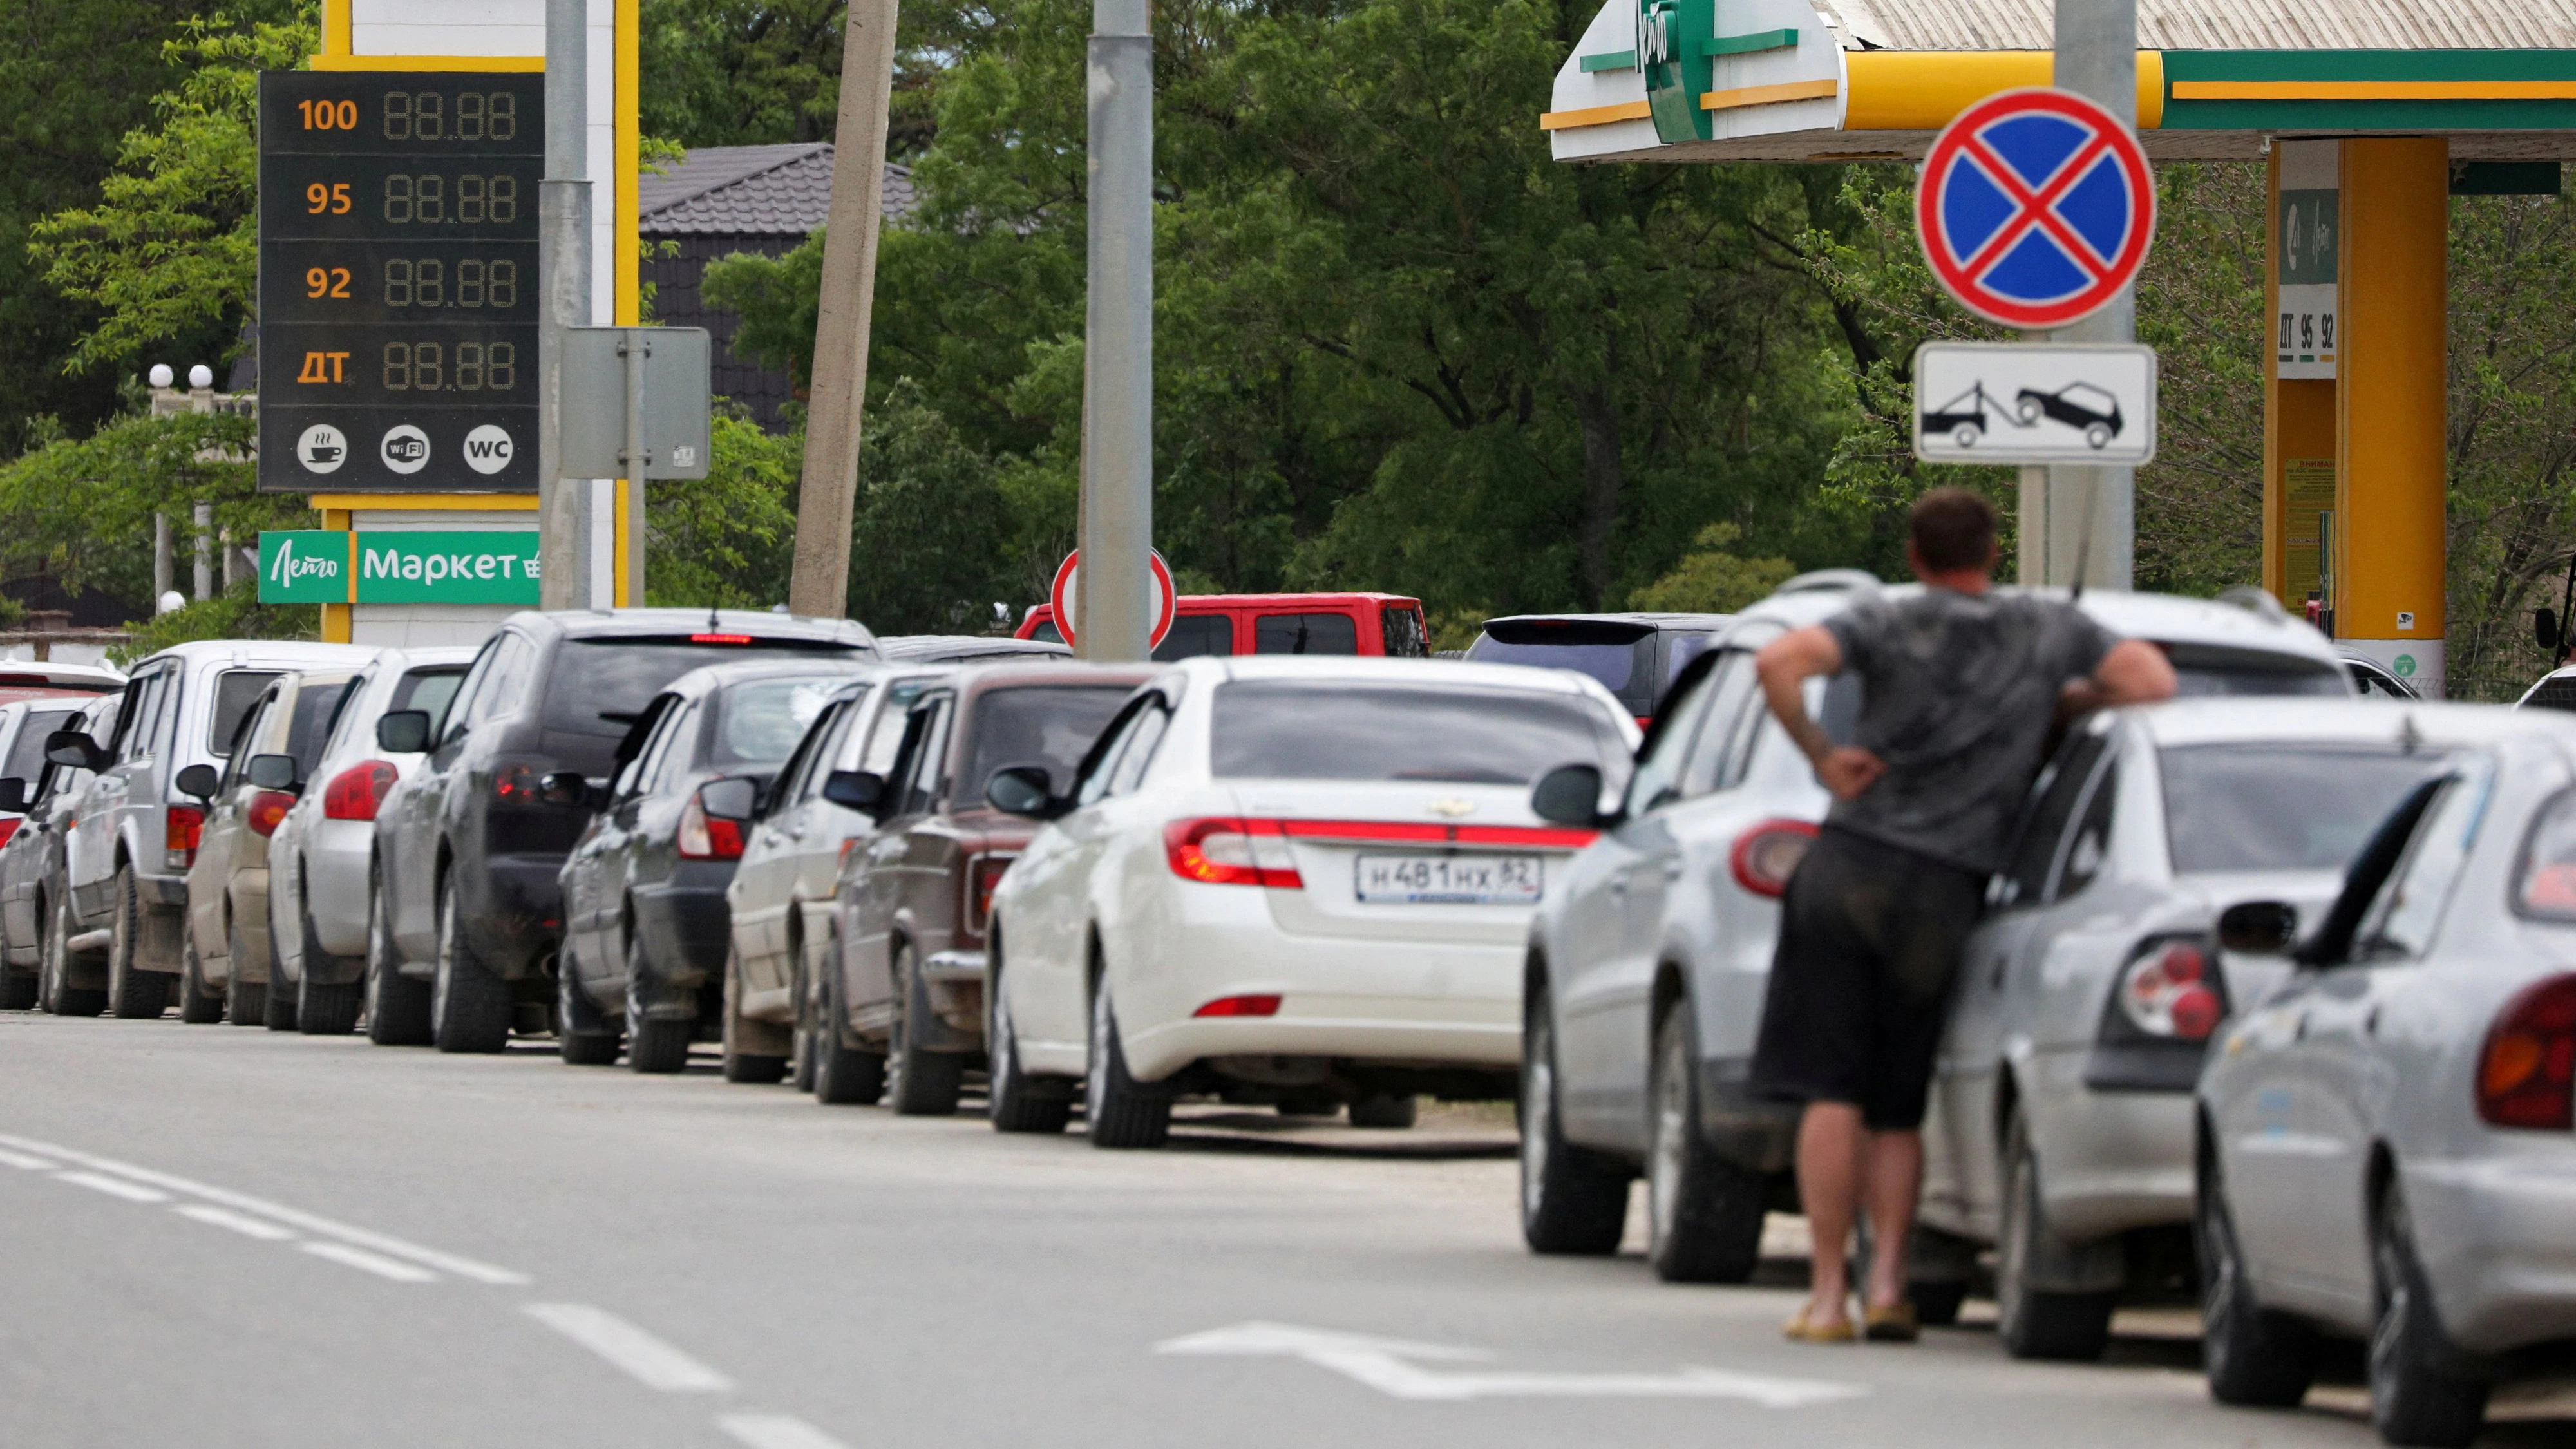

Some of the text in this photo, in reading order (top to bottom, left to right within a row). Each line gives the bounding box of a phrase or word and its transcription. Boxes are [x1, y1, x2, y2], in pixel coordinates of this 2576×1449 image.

[298, 100, 357, 130] 100
[307, 183, 351, 214] 95
[306, 267, 350, 298] 92
[2301, 314, 2313, 348] 95
[2322, 314, 2333, 348] 92
[297, 352, 350, 383] ДТ
[469, 440, 508, 459] WC
[270, 538, 337, 588] Лето
[363, 549, 518, 586] Маркет
